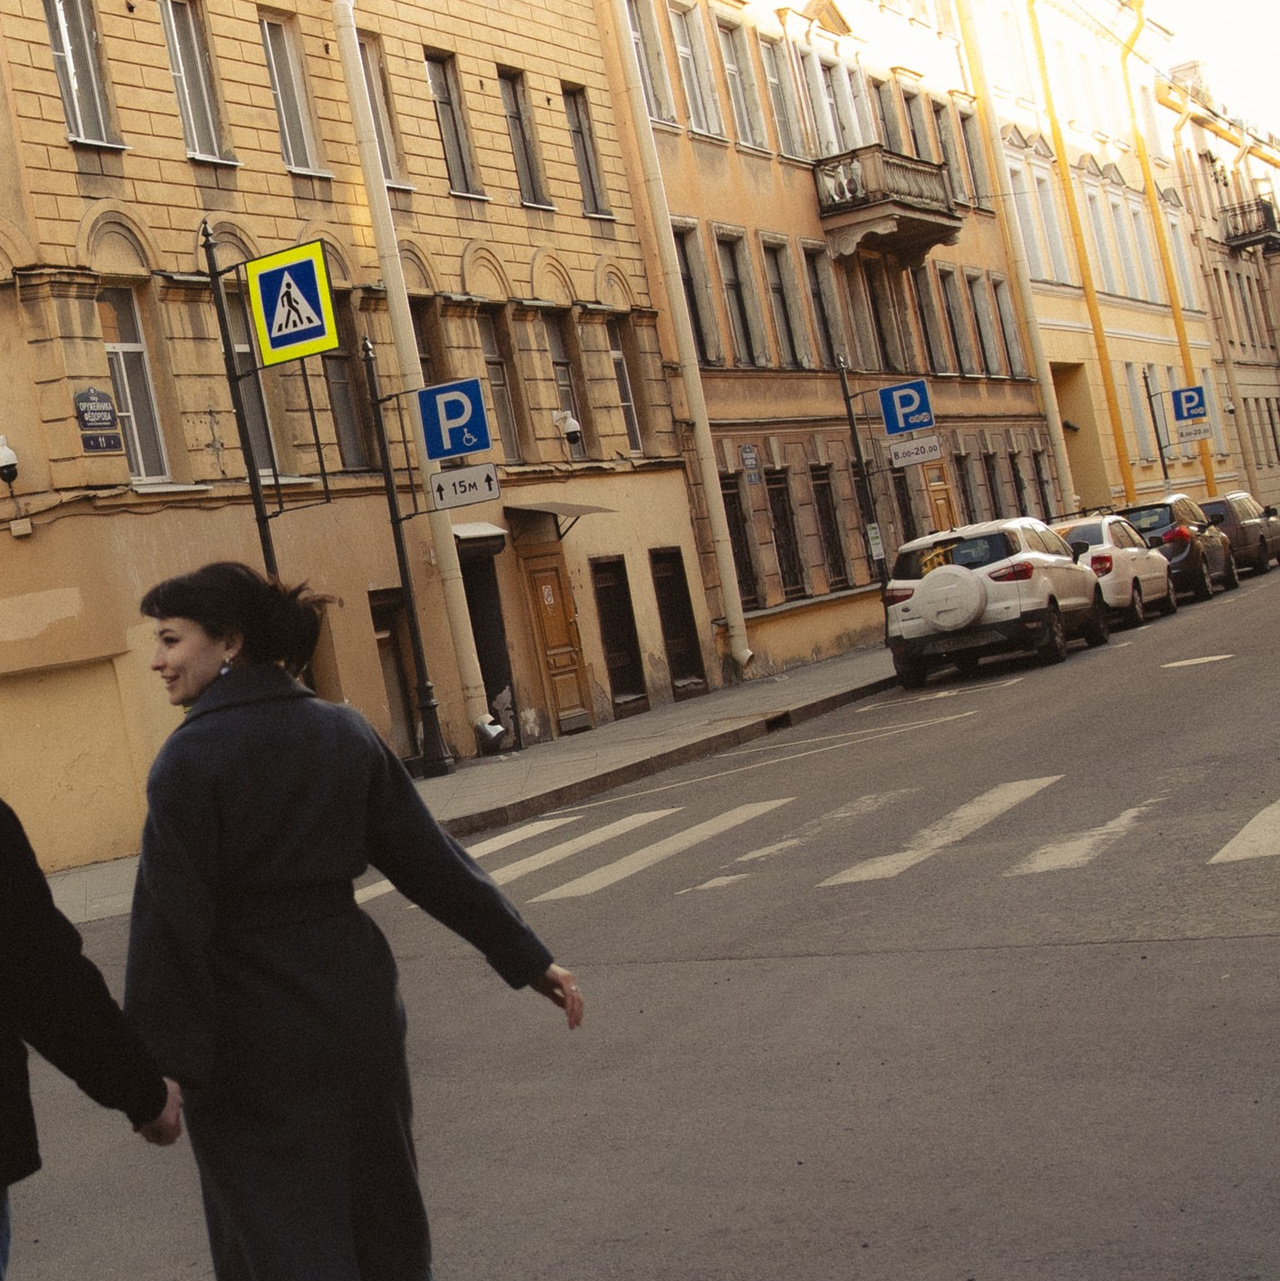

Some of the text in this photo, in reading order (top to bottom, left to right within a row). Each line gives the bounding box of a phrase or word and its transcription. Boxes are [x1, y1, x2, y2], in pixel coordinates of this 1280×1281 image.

[892, 388, 920, 428] P
[1180, 391, 1199, 417] P
[436, 391, 472, 450] P
[98, 436, 106, 448] 11
[893, 444, 938, 460] 8.00-20.00
